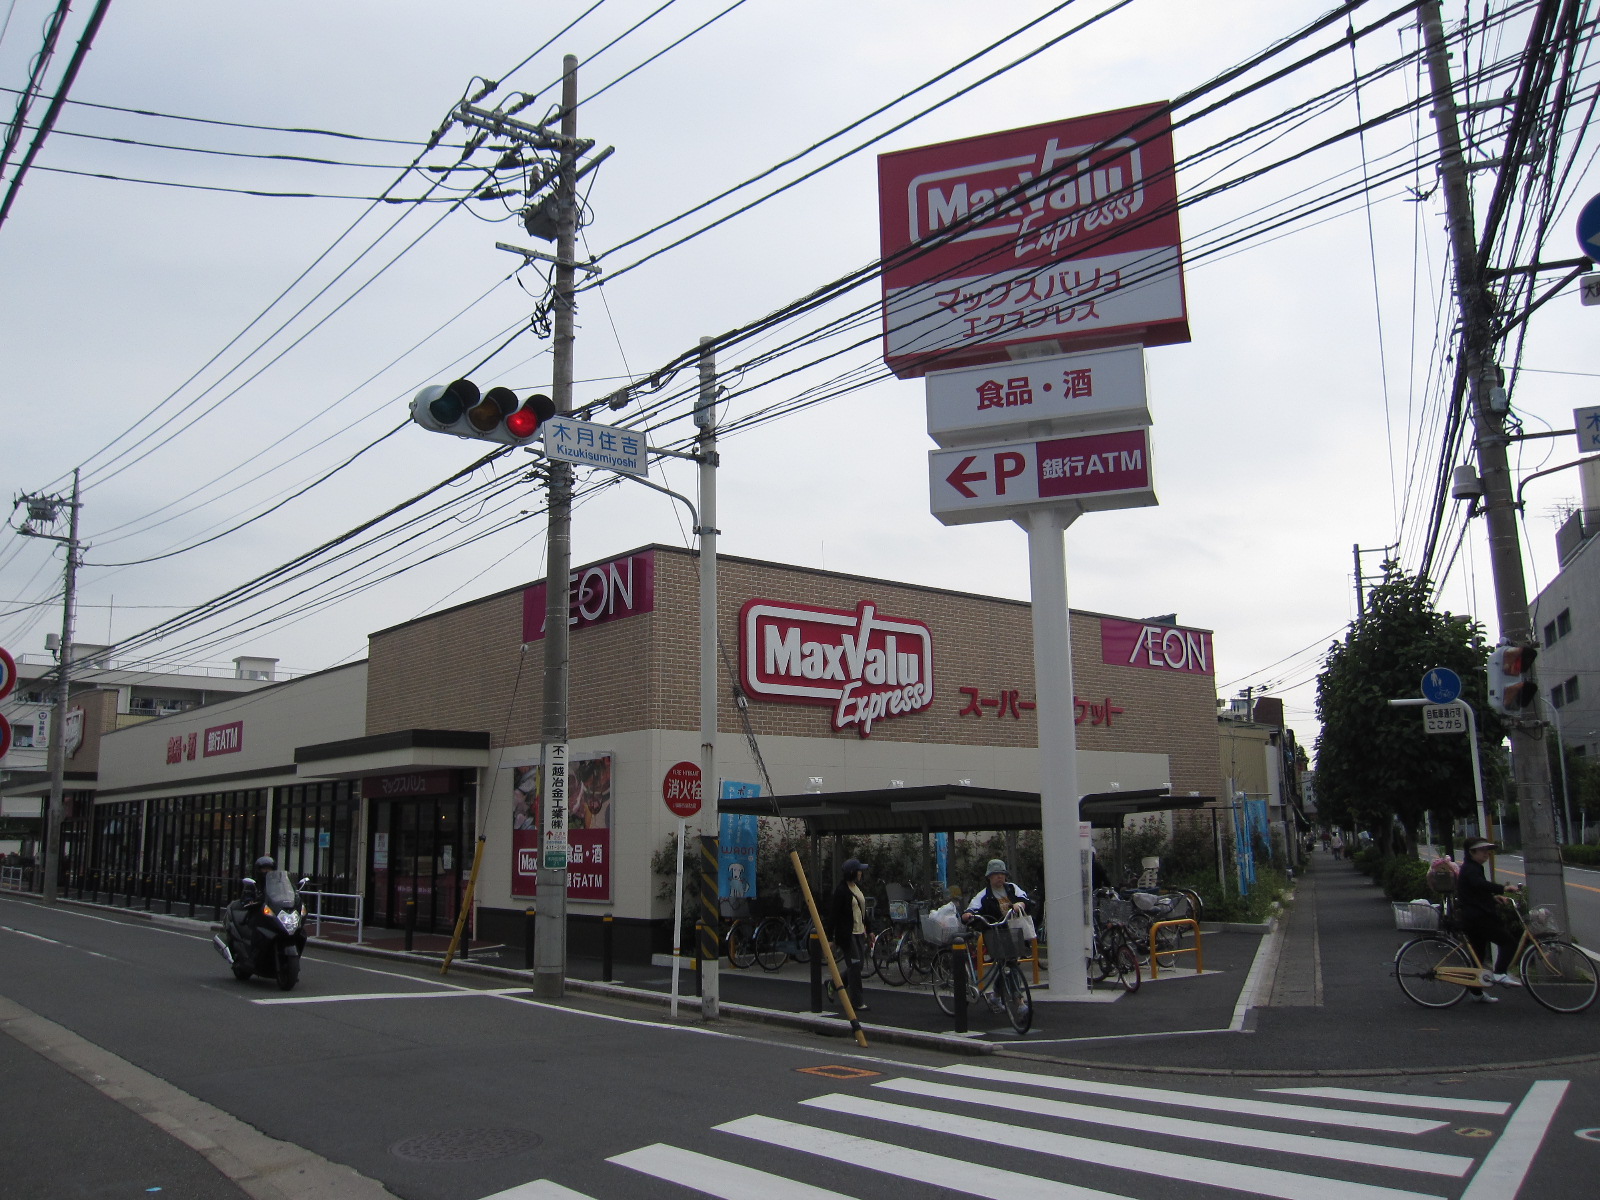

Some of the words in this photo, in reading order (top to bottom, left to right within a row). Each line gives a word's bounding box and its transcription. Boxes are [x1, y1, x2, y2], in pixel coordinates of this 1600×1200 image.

[927, 138, 1122, 231] MaxValu
[1014, 195, 1131, 258] Express
[935, 268, 1121, 314] マックスバリュ
[962, 300, 1100, 339] エクスプレス
[976, 368, 1093, 410] 食品・酒
[552, 423, 638, 456] 木月住吉
[557, 444, 637, 469] Kizukisumiyoshi
[994, 451, 1026, 495] P
[1042, 449, 1142, 480] 銀行ATM
[764, 605, 919, 686] MaxValu
[836, 680, 925, 734] Express
[959, 686, 1124, 726] スーパーケット
[1427, 708, 1461, 719] 自転車通行可
[1428, 720, 1462, 730] ここから
[381, 775, 426, 794] マックスバリュ
[667, 778, 701, 800] 消火栓
